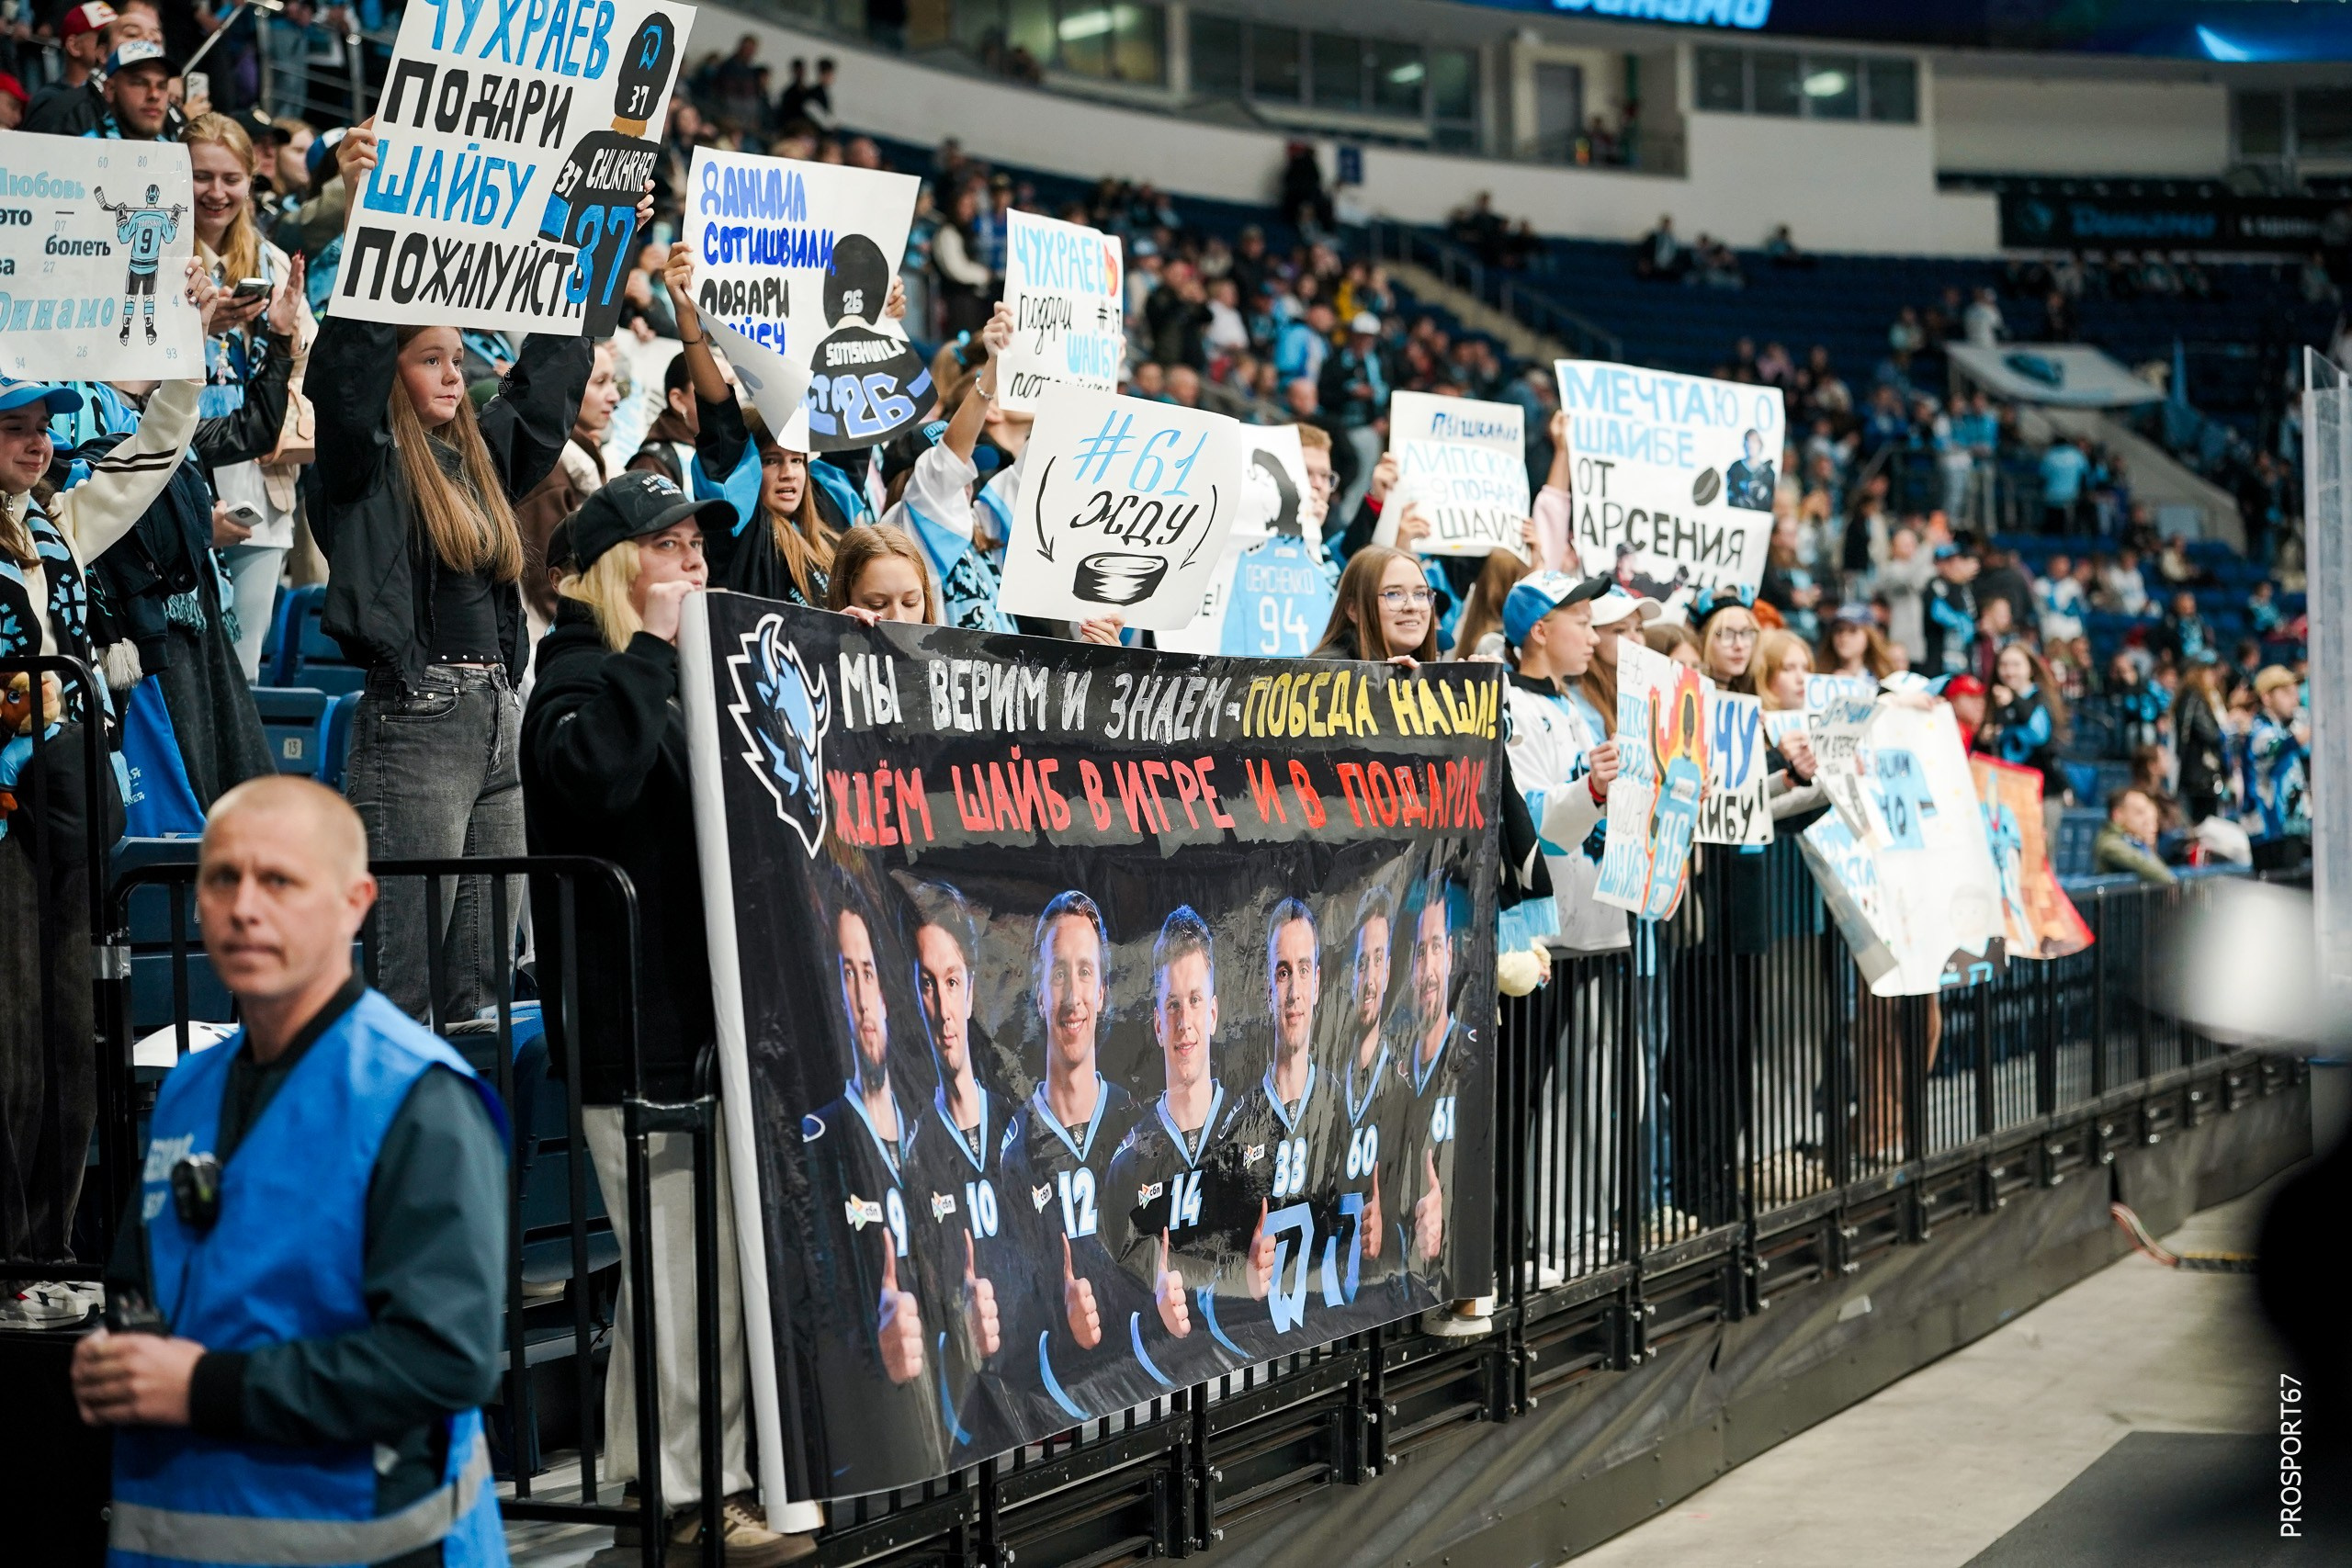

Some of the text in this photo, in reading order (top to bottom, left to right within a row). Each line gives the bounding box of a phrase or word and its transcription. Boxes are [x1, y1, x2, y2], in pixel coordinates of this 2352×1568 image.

[424, 0, 616, 80] ЧУХРАЕВ
[382, 58, 573, 150] ПОДАРИ
[628, 85, 650, 117] 37
[97, 156, 108, 168] 60
[138, 155, 148, 167] 80
[363, 139, 537, 230] ШАЙБУ
[555, 159, 583, 198] 37
[700, 161, 807, 222] ДАНИИЛ
[45, 234, 111, 256] болеть
[54, 220, 67, 231] 07
[140, 228, 153, 254] 9
[0, 258, 15, 276] а
[43, 262, 55, 274] 27
[565, 204, 637, 306] 37
[1014, 223, 1107, 295] ЧУХРАЕВ
[172, 294, 179, 307] 4
[698, 276, 790, 319] ПОДАРИ
[842, 288, 864, 314] 26
[1019, 292, 1072, 355] подари
[15, 356, 26, 369] 94
[76, 345, 88, 358] 26
[165, 347, 178, 359] 93
[729, 317, 786, 355] ЙБУ
[1067, 330, 1118, 381] ШАЙБУ
[842, 371, 917, 439] 26
[1562, 366, 1774, 432] МЕЧТАЮ О
[1073, 410, 1210, 497] #61
[1574, 416, 1695, 469] ШАЙБЕ
[1578, 457, 1616, 498] ОТ
[1069, 491, 1200, 547] ЖДУ
[1436, 505, 1525, 553] ШАЙБ
[1579, 502, 1747, 570] АРСЕНИЯ
[1259, 595, 1310, 656] 94
[838, 652, 903, 728] МЫ
[928, 659, 1049, 732] ВЕРИМ
[1062, 669, 1092, 731] И
[1388, 678, 1498, 740] НАША!
[288, 740, 300, 756] 13
[1711, 699, 1759, 790] ЧУ
[826, 744, 1486, 846] ЖДЁМ ШАЙБ В ИГРЕ И В ПОДАРОК
[1700, 775, 1769, 842] ЙБУ!
[1656, 810, 1690, 882] 96
[1431, 1095, 1457, 1143] 61
[1272, 1136, 1307, 1198] 33
[1346, 1123, 1378, 1180] 60
[886, 1186, 909, 1258] 9
[966, 1179, 999, 1240] 10
[1057, 1167, 1098, 1240] 12
[1149, 1169, 1204, 1231] сбп 14
